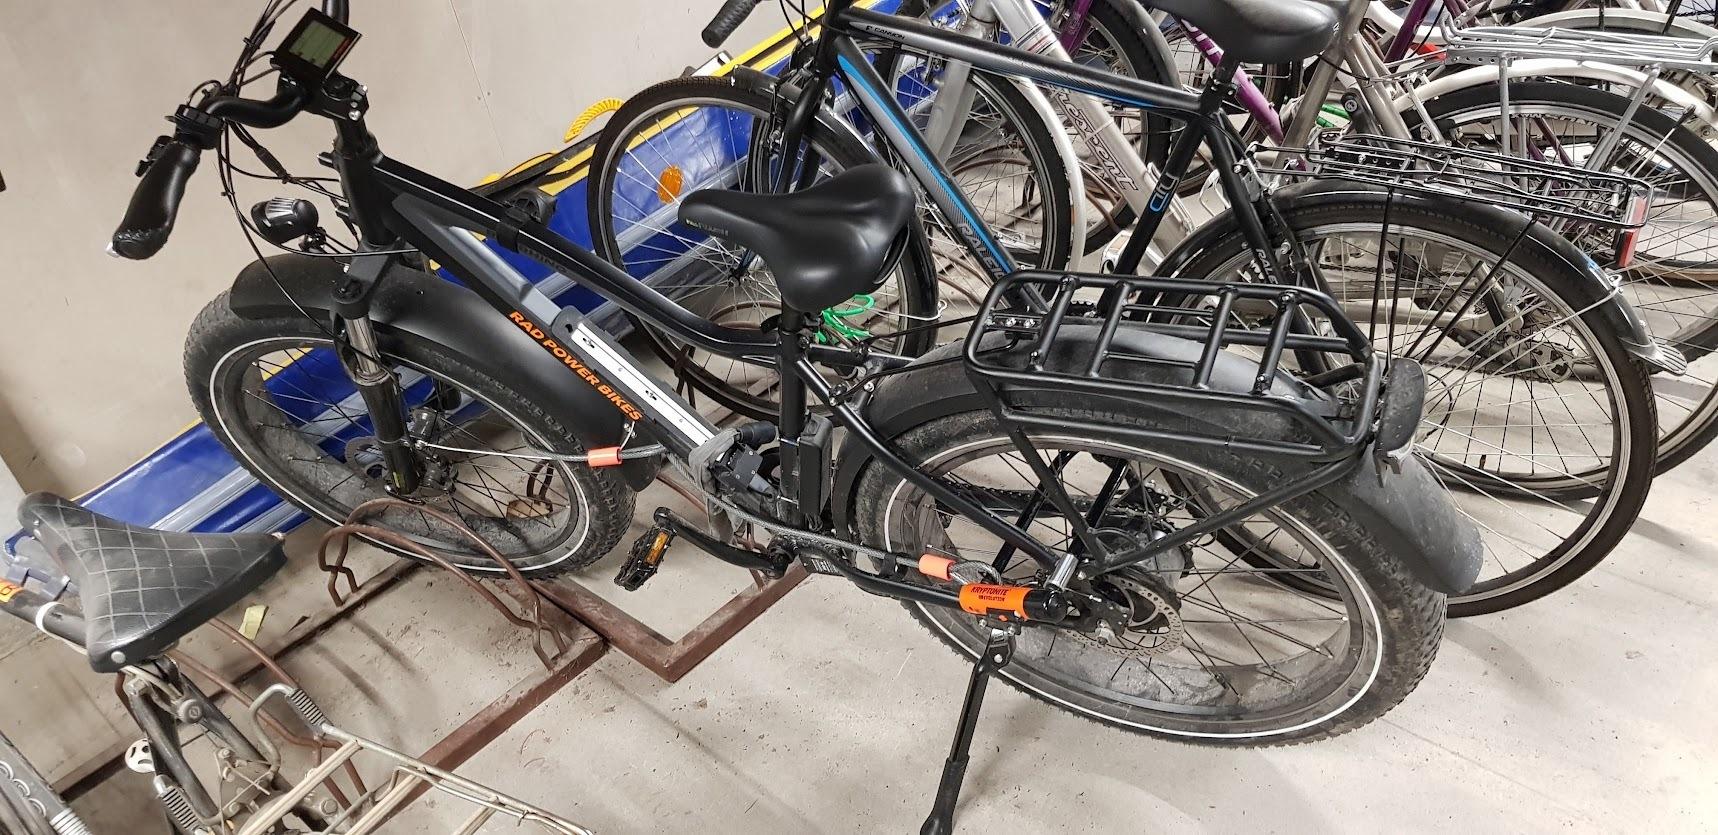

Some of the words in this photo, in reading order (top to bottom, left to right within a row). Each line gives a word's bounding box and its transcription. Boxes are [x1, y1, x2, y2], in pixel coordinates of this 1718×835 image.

[1049, 84, 1138, 190] rescent
[957, 223, 1006, 280] RALEI
[1255, 248, 1279, 284] RALE
[509, 311, 545, 340] RAD
[543, 339, 601, 386] POWER
[597, 383, 644, 422] BIKES
[970, 586, 1009, 596] KRYPTONITE
